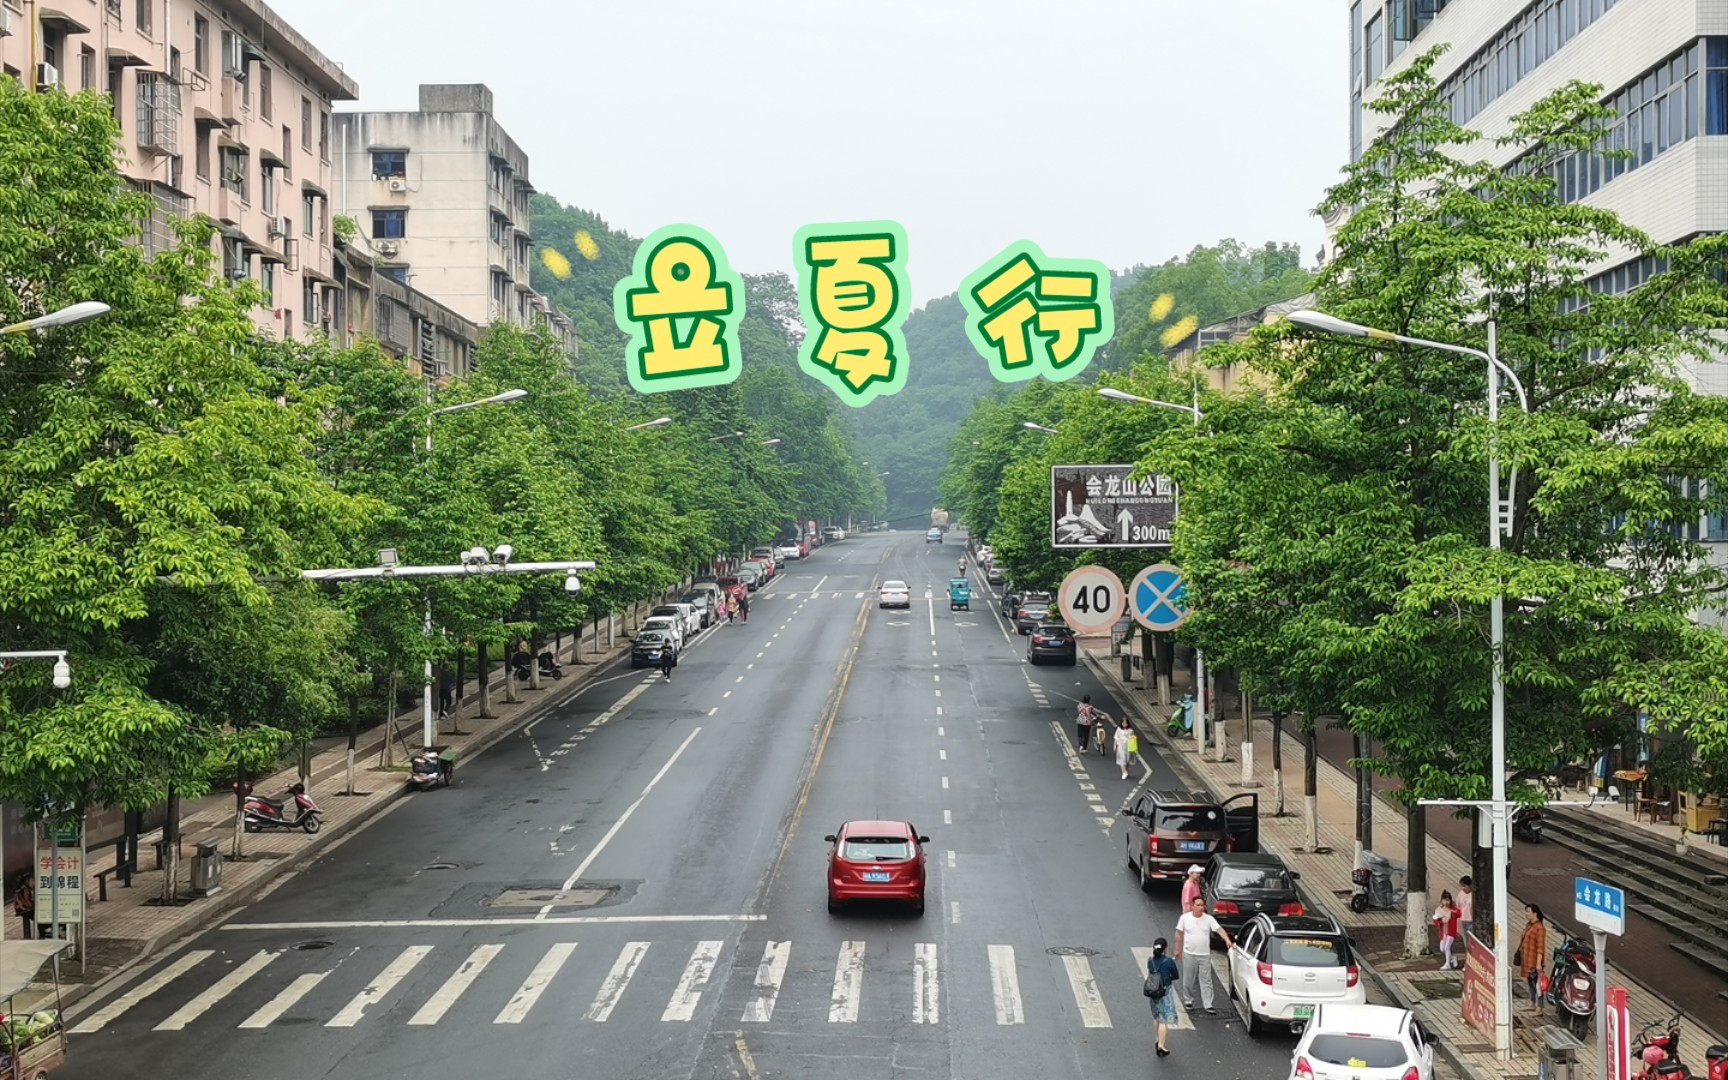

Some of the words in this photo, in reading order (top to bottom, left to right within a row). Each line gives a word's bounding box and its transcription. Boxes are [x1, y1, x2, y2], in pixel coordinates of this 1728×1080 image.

[1086, 474, 1171, 496] 会龙山公园
[1132, 525, 1170, 541] 300m
[1072, 584, 1110, 614] 40
[40, 856, 79, 870] 学会计
